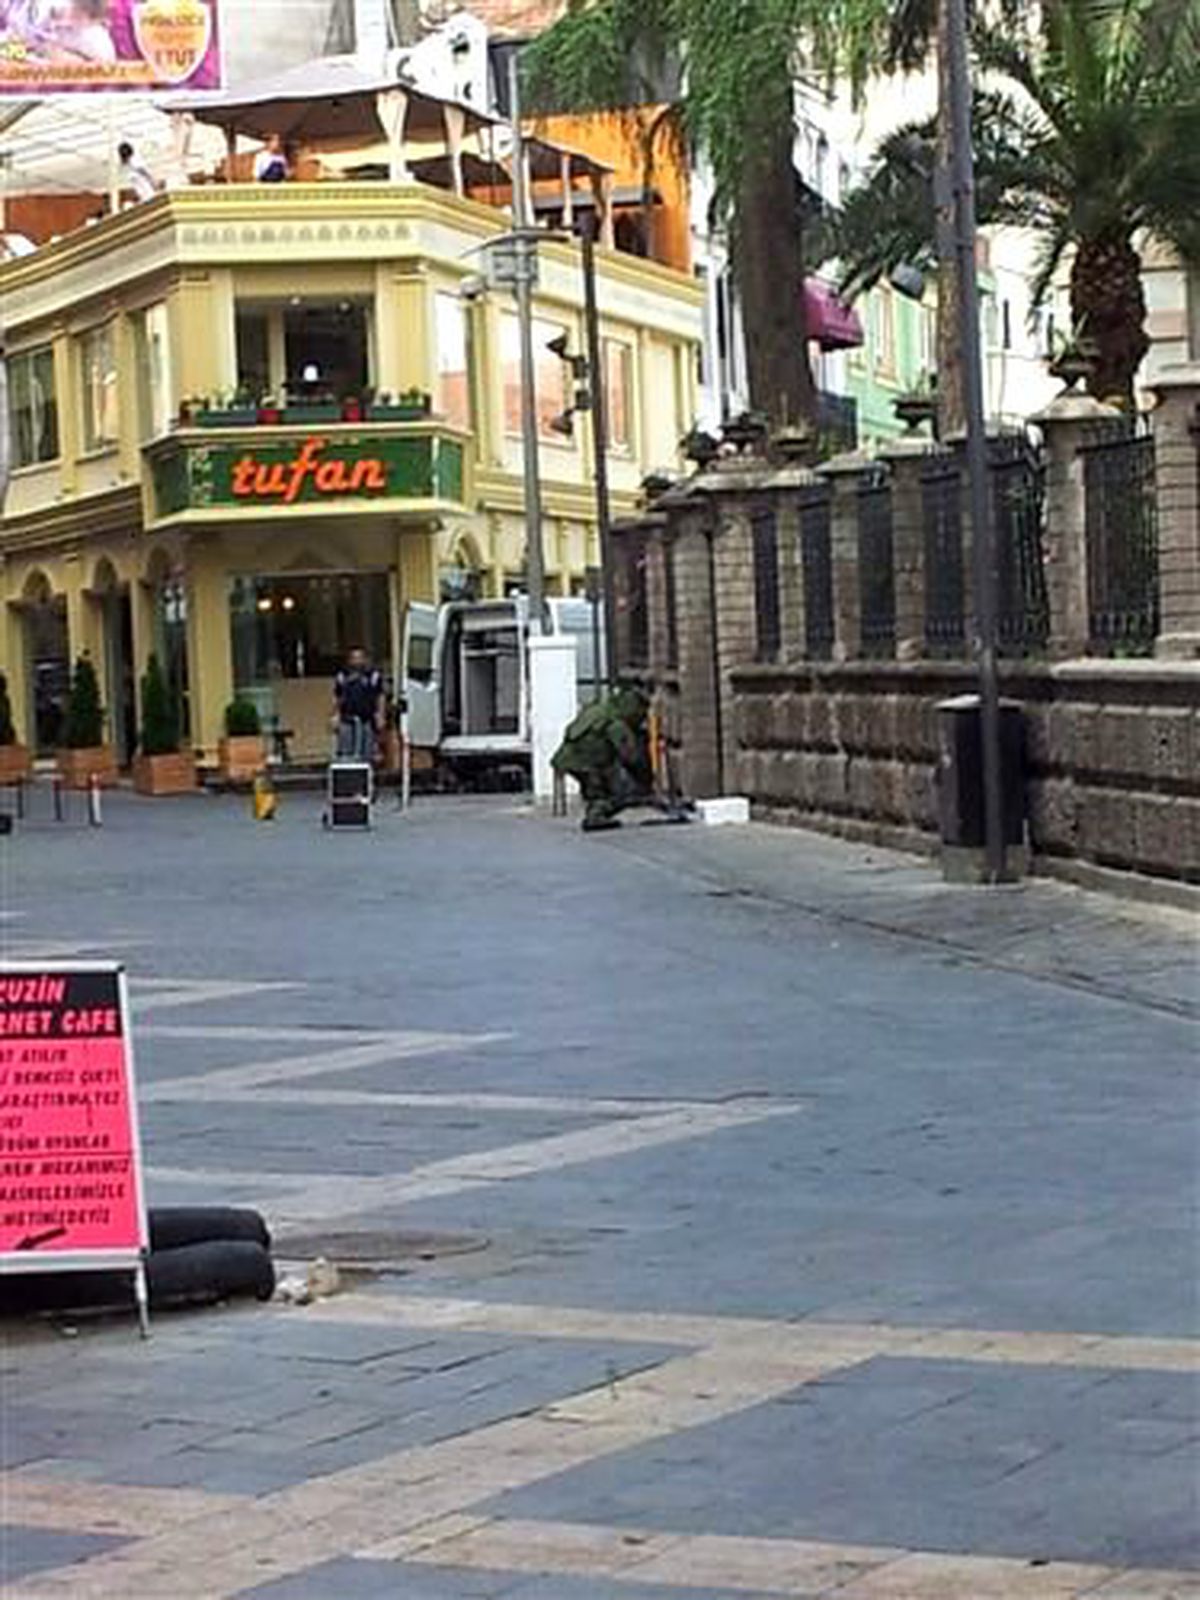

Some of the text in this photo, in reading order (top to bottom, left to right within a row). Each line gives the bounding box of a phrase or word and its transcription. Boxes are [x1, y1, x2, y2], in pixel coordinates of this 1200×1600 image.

[230, 436, 386, 501] tufan
[61, 1007, 117, 1033] CAFE
[45, 1132, 109, 1150] OYUNLAR
